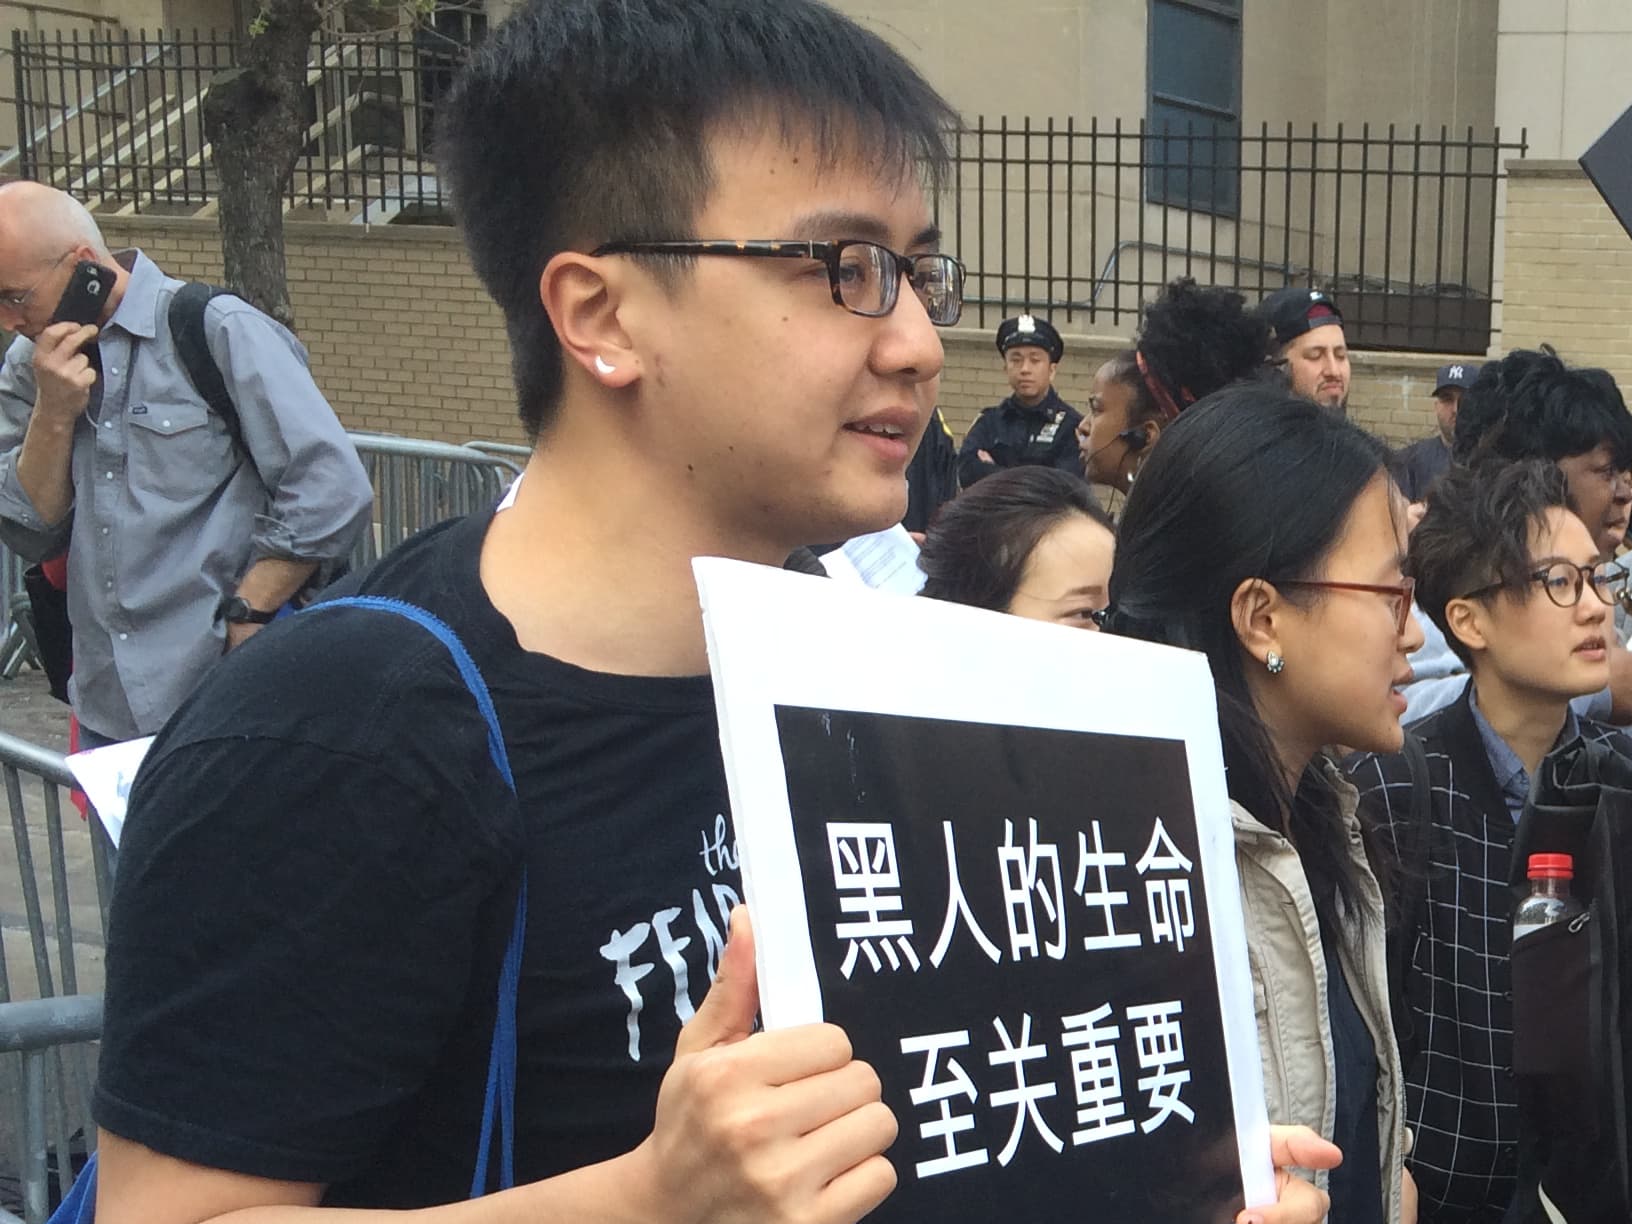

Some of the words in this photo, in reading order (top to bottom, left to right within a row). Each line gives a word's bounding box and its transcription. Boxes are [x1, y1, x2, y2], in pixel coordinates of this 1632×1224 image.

[825, 815, 1198, 981] 黑人的生命
[899, 999, 1197, 1180] 至关重要
